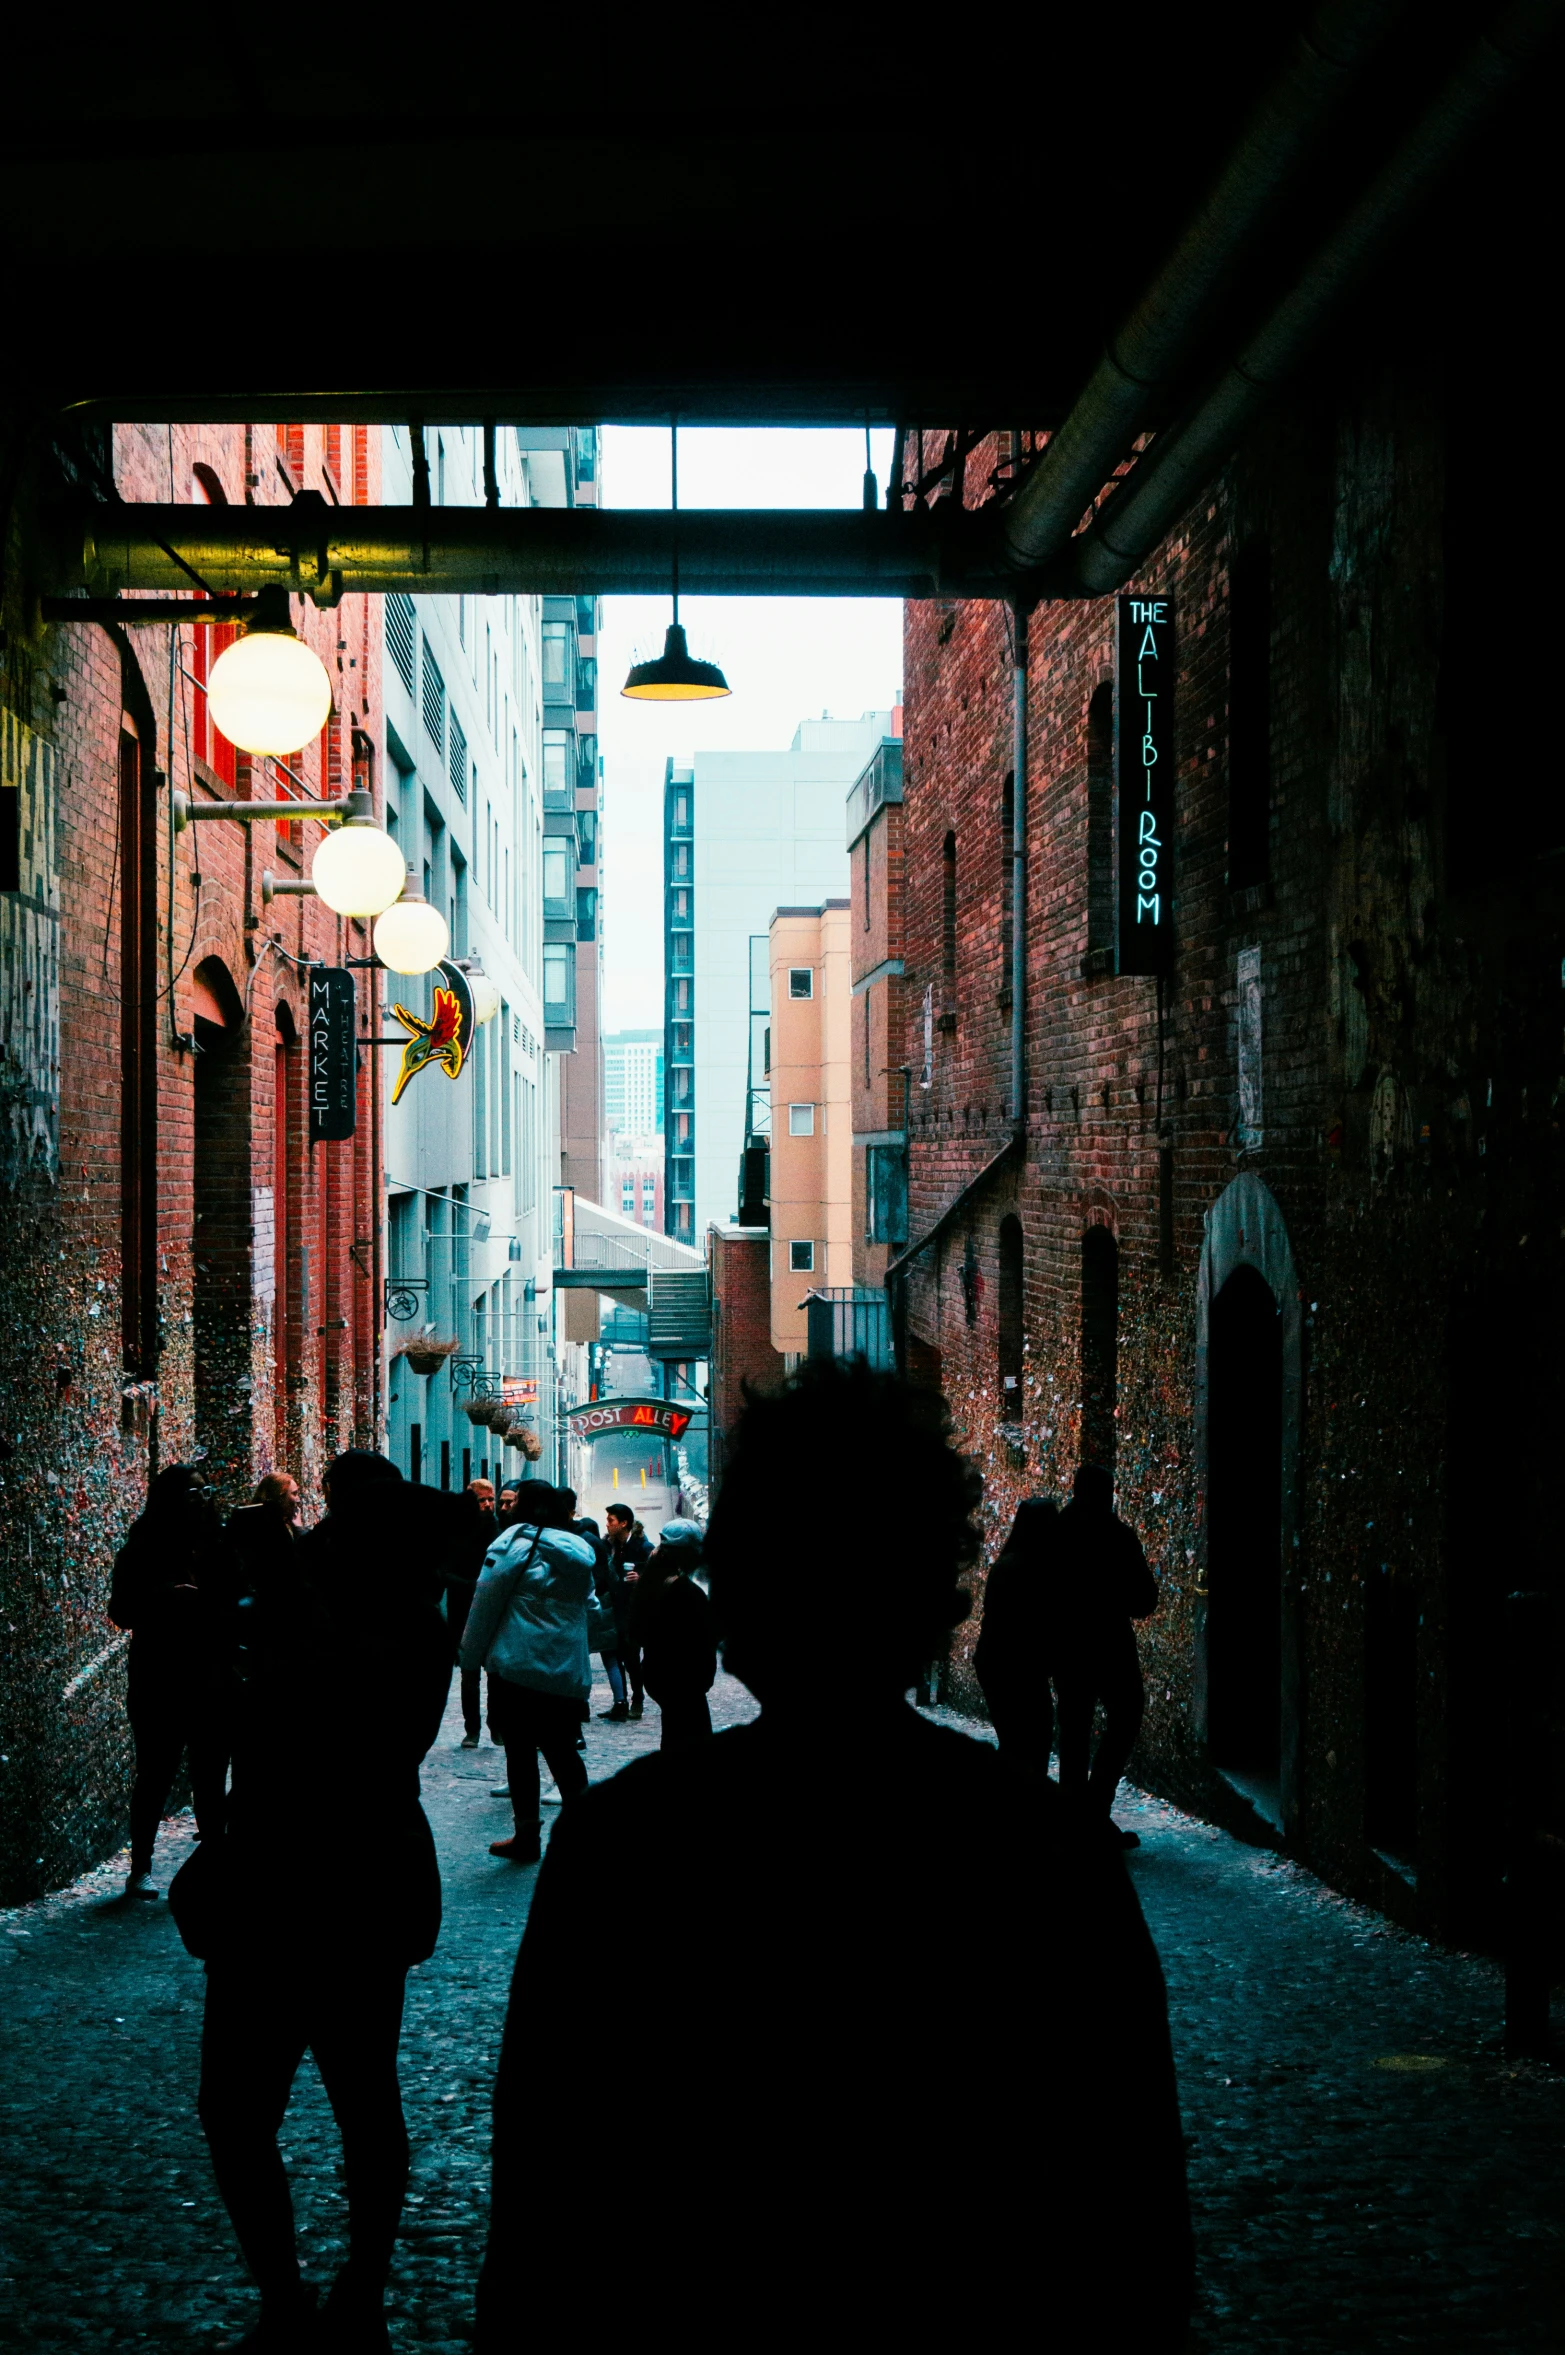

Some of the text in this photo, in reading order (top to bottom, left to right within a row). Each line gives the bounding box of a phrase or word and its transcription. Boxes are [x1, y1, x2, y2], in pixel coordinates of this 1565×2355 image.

[1130, 602, 1168, 624] THE
[1137, 624, 1161, 926] ALIBI ROOM
[312, 981, 330, 1126] MARKET
[339, 999, 350, 1109] THEATRE
[578, 1406, 688, 1436] POST ALLEY
